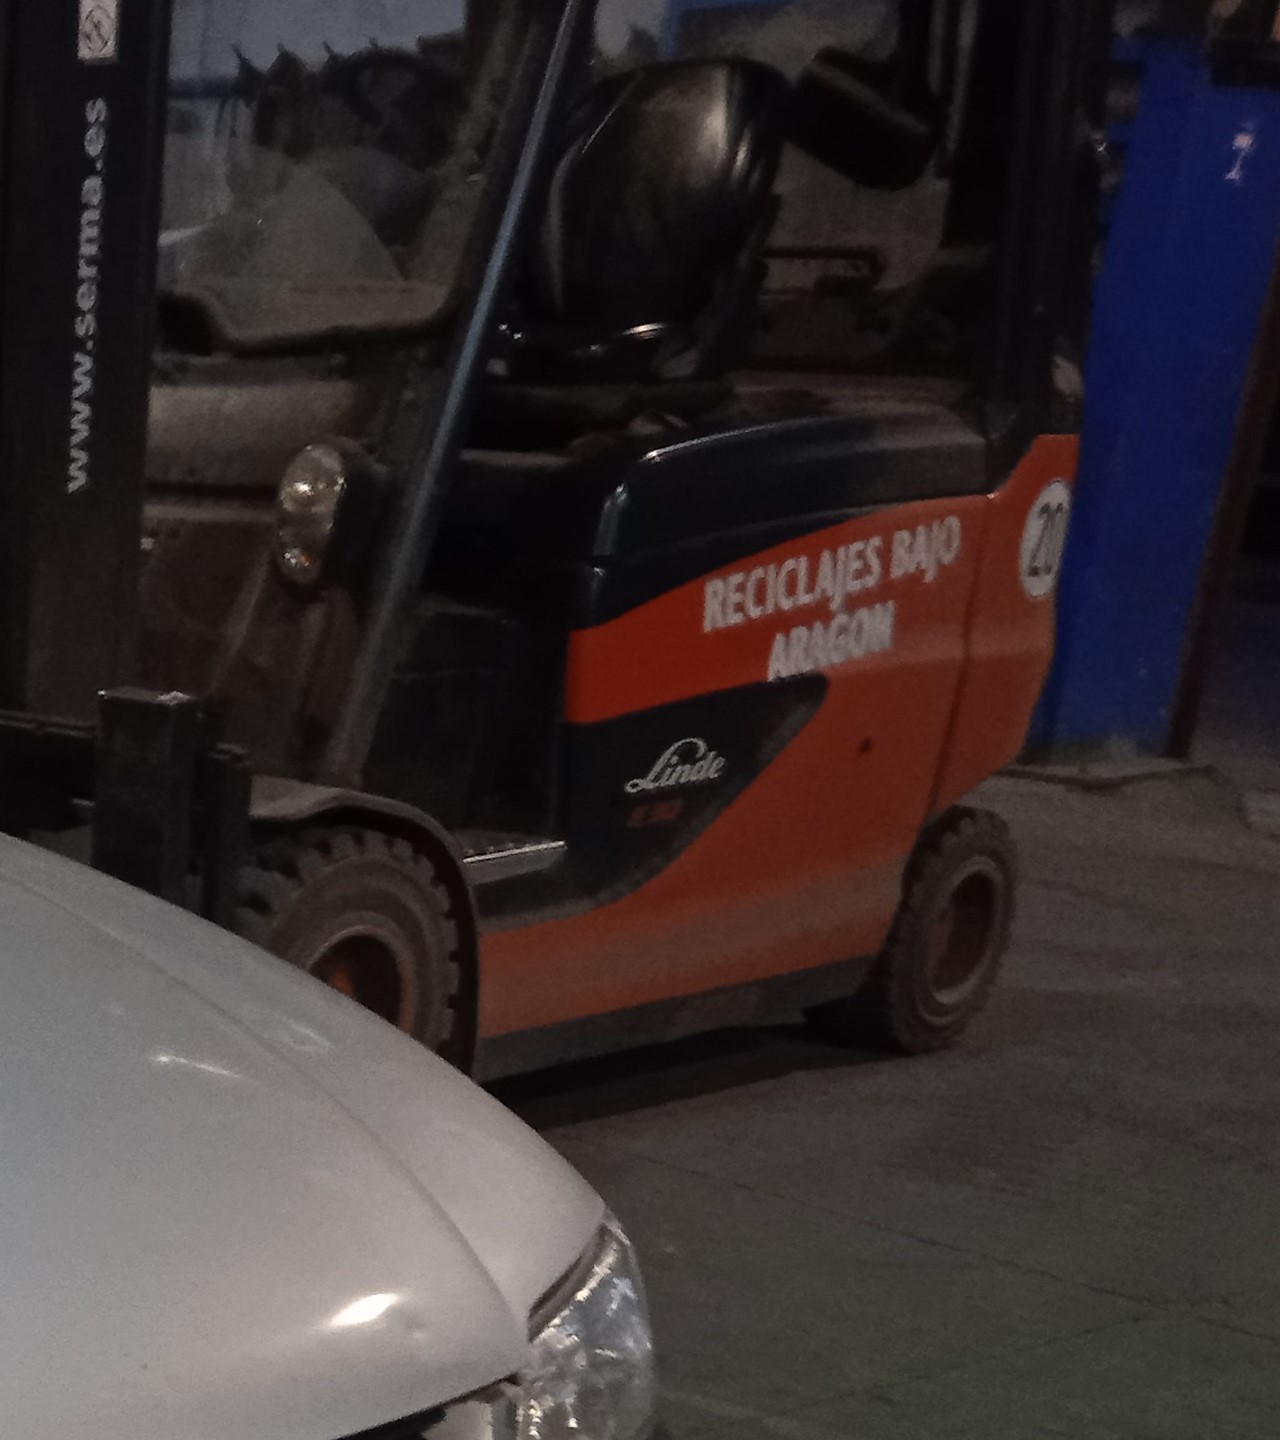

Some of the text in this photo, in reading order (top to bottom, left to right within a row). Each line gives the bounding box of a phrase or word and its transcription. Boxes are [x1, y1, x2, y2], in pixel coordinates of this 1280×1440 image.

[67, 98, 108, 494] www.serma.es
[702, 515, 961, 632] RECICLAJES BAJO
[1027, 502, 1067, 577] 20
[767, 600, 896, 682] ARAGON
[624, 736, 726, 794] Linde
